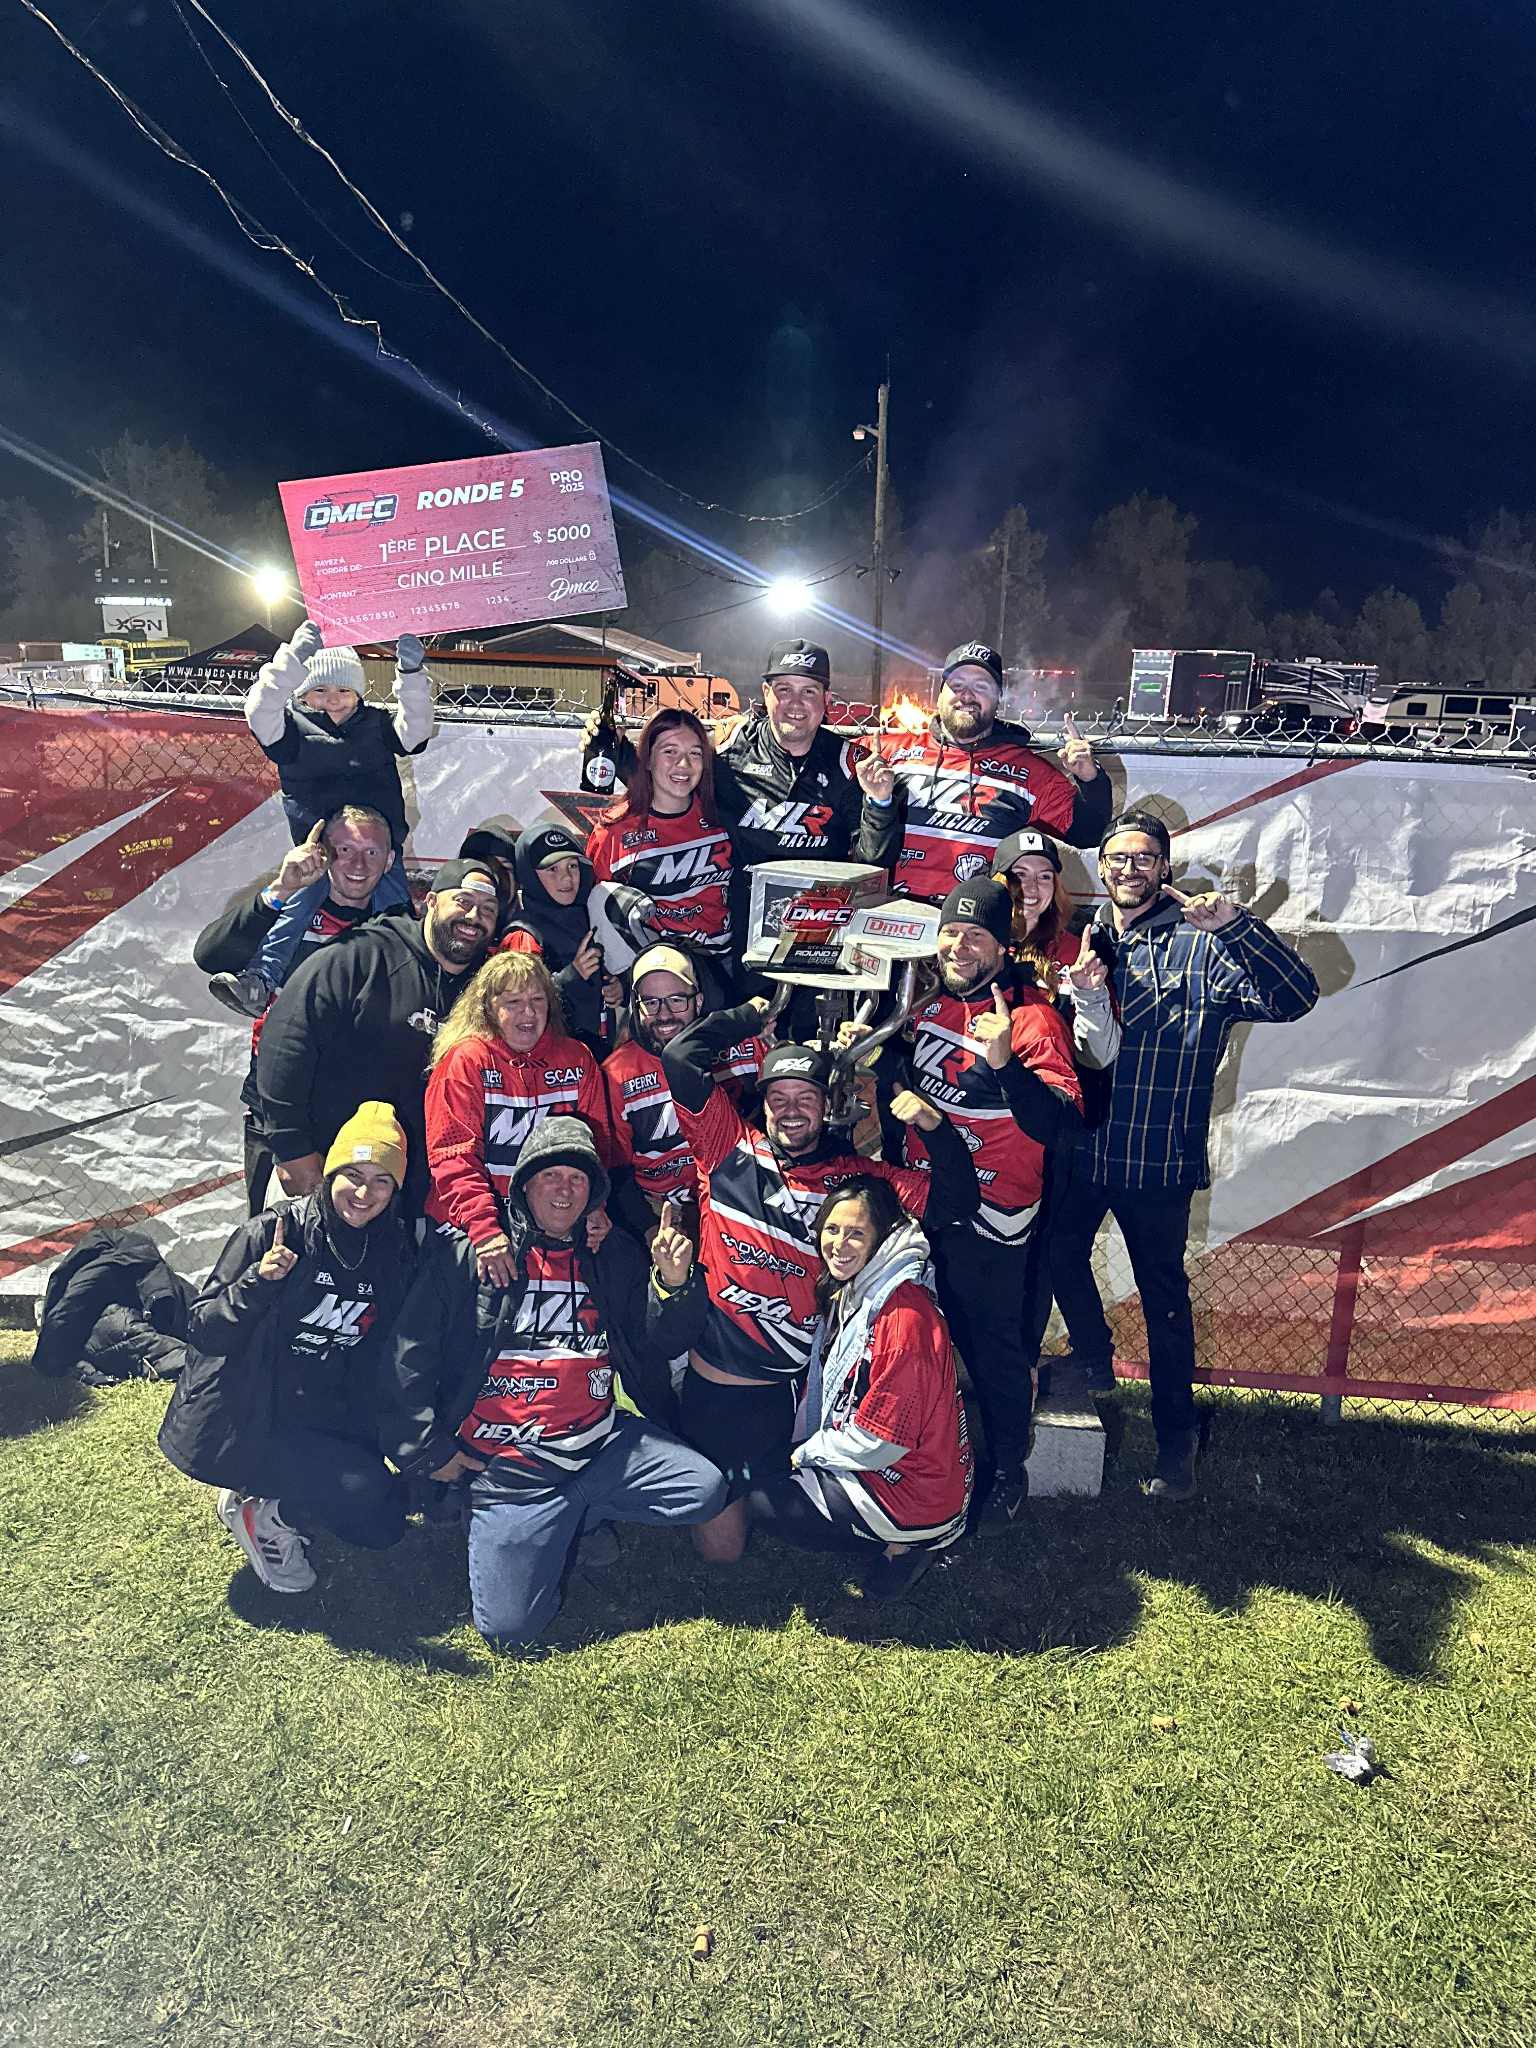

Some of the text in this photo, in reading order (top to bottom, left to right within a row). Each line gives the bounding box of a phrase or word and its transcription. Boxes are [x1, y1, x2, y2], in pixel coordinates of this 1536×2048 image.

[550, 469, 583, 485] PRO
[559, 482, 585, 494] 2025
[417, 479, 525, 511] RONDE 5
[425, 527, 506, 557] PLACE
[532, 523, 591, 544] $ 5000
[397, 560, 503, 589] CINQ MILLE
[320, 590, 357, 600] MONTANT
[411, 602, 461, 615] 12345678
[486, 595, 510, 606] 1234
[779, 653, 817, 668] HEXA
[979, 759, 1030, 782] SCALE
[738, 799, 834, 836] MLR
[925, 812, 990, 834] RACING
[651, 842, 732, 885] MLR
[628, 1072, 658, 1092] PERRY
[920, 1075, 967, 1104] RACING
[719, 1284, 792, 1315] HEXA
[473, 1416, 546, 1445] HEXA
